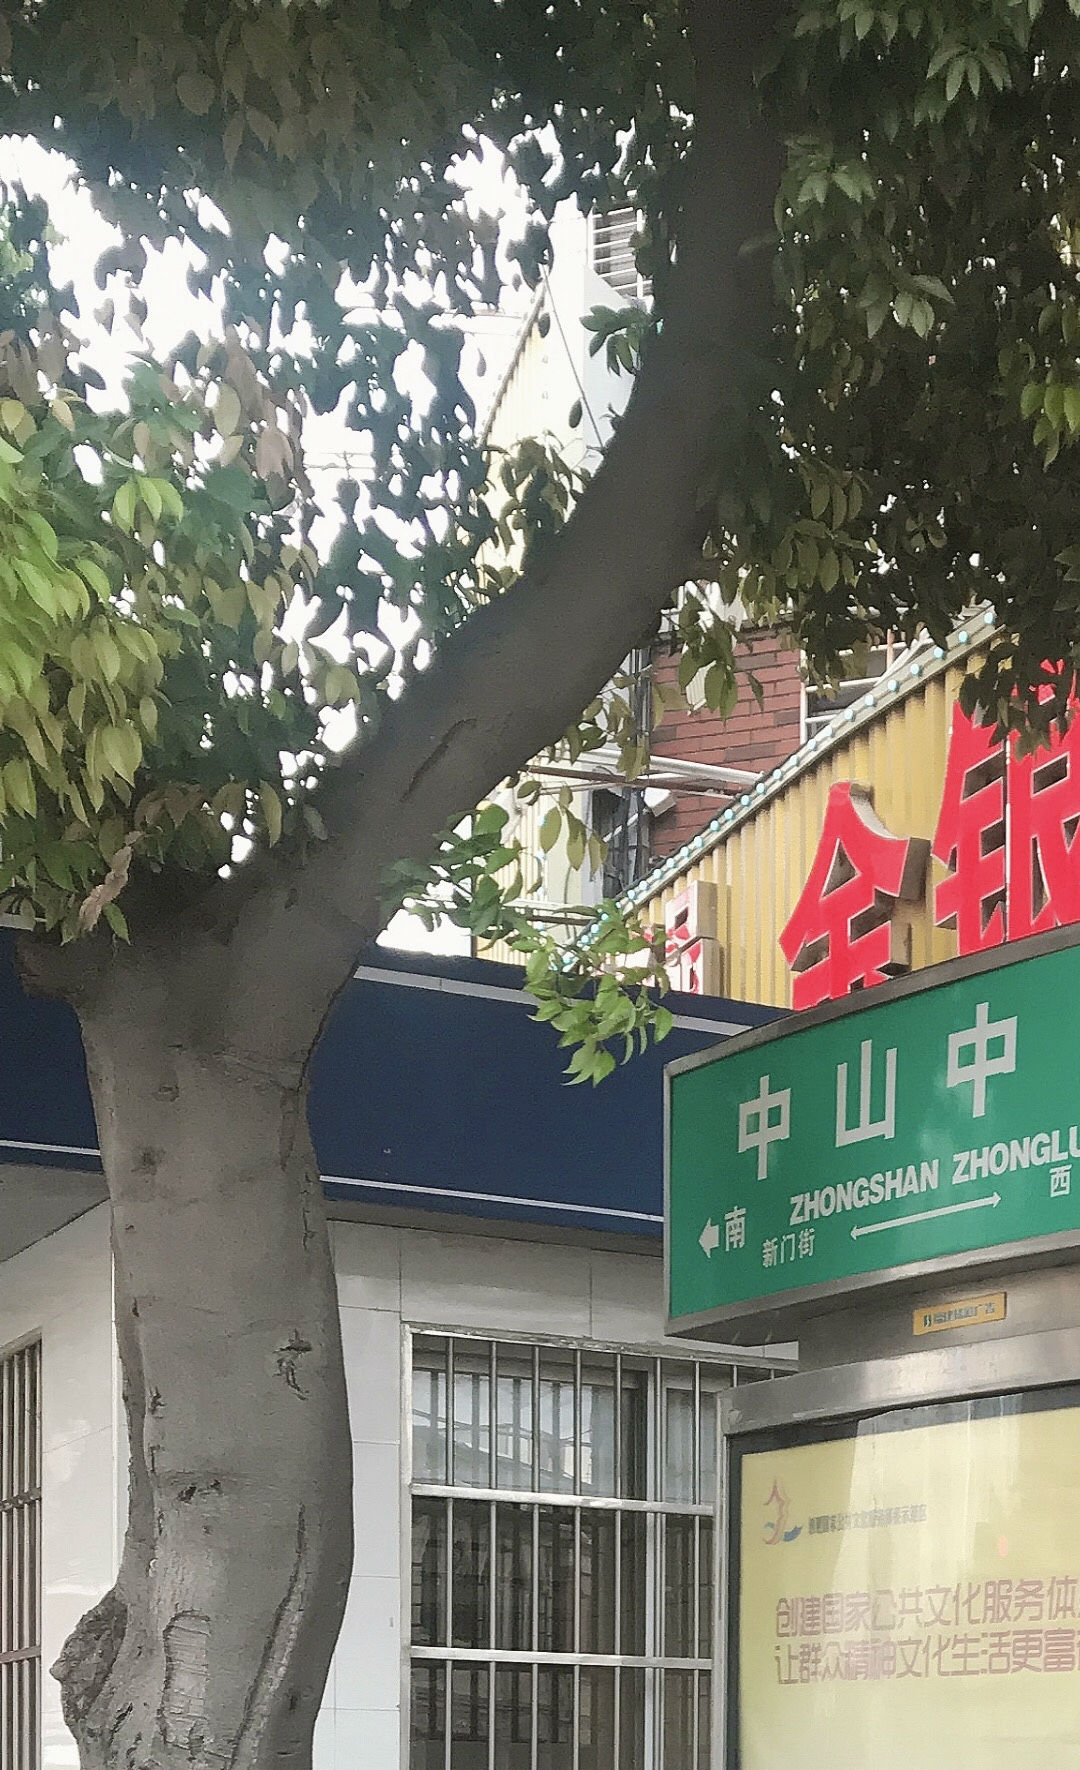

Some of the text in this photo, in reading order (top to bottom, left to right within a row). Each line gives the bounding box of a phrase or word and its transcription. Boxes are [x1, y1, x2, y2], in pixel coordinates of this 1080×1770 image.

[790, 1157, 939, 1226] ZHONGSHAN
[724, 1207, 747, 1251] 南
[762, 1228, 816, 1269] 新门街
